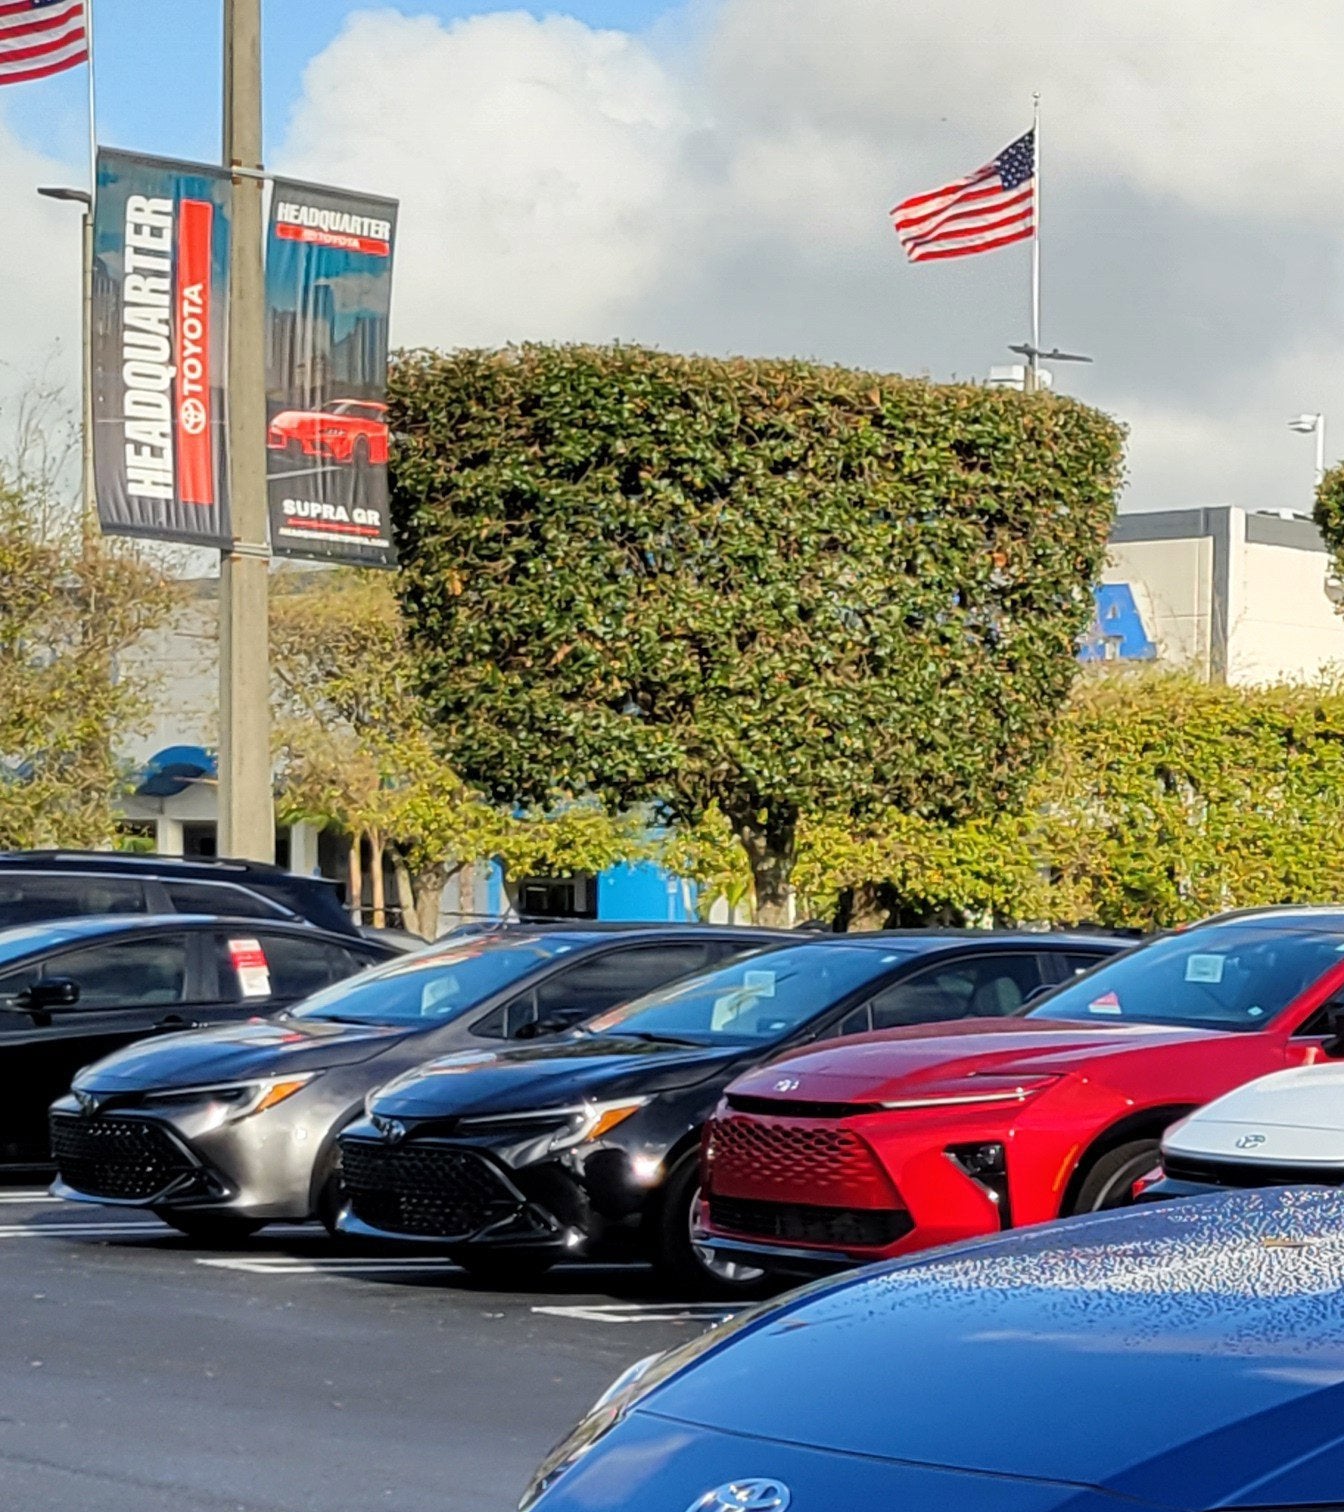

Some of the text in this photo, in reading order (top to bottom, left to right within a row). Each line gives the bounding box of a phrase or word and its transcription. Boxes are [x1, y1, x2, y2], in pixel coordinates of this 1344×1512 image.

[278, 202, 390, 241] HEADQUARTER
[123, 195, 177, 499] HEADQUARTER
[183, 283, 204, 395] TOYOTA
[282, 499, 381, 526] SUPRA GR
